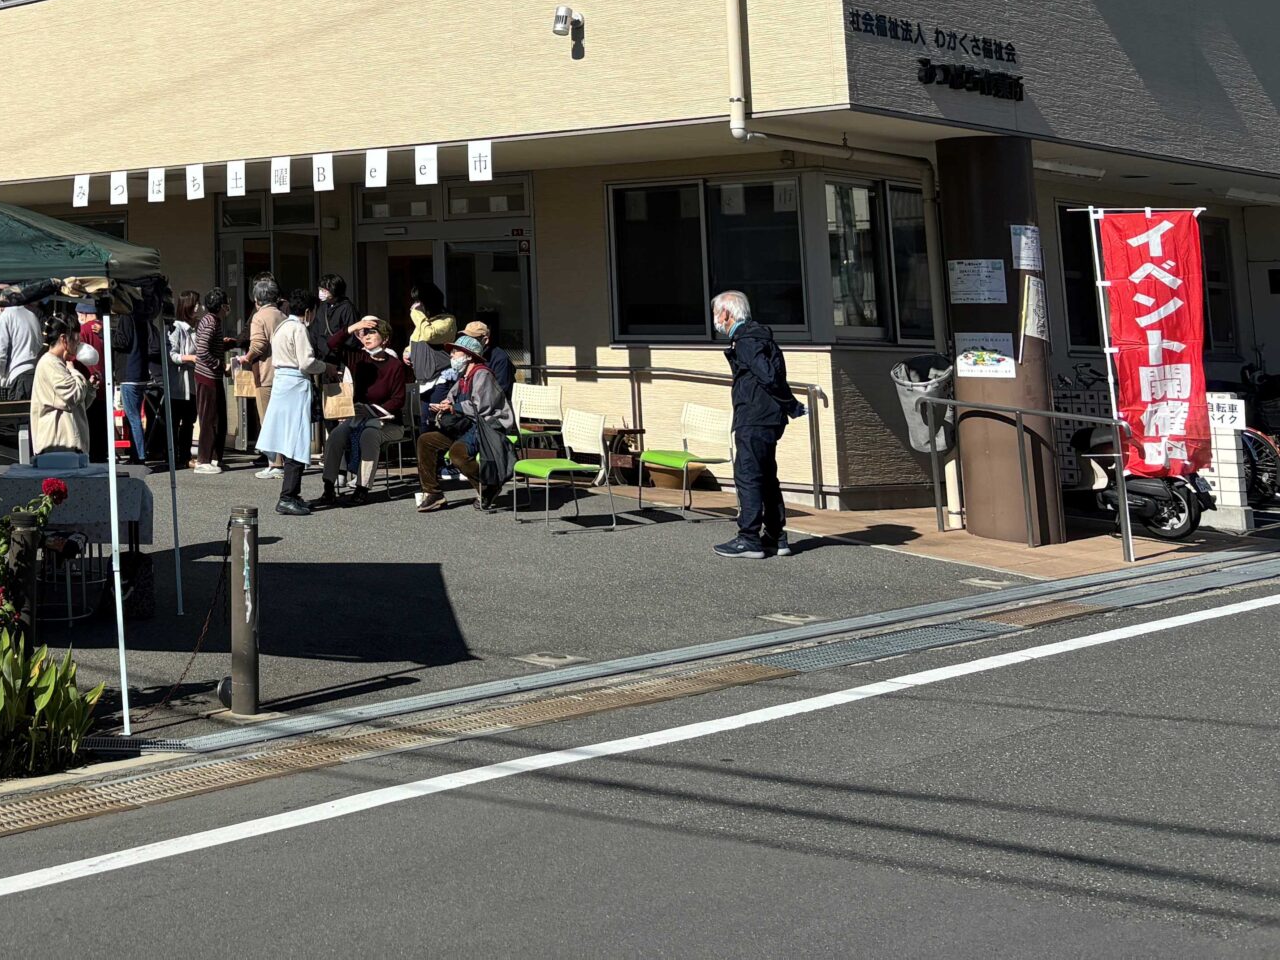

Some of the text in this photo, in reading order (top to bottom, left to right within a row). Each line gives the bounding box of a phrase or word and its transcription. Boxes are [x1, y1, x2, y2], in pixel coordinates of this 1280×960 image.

[849, 9, 1016, 64] 社会福祉法人 わかくさ福祉会
[1127, 220, 1191, 466] イベント開催中
[1207, 402, 1238, 413] 自転車
